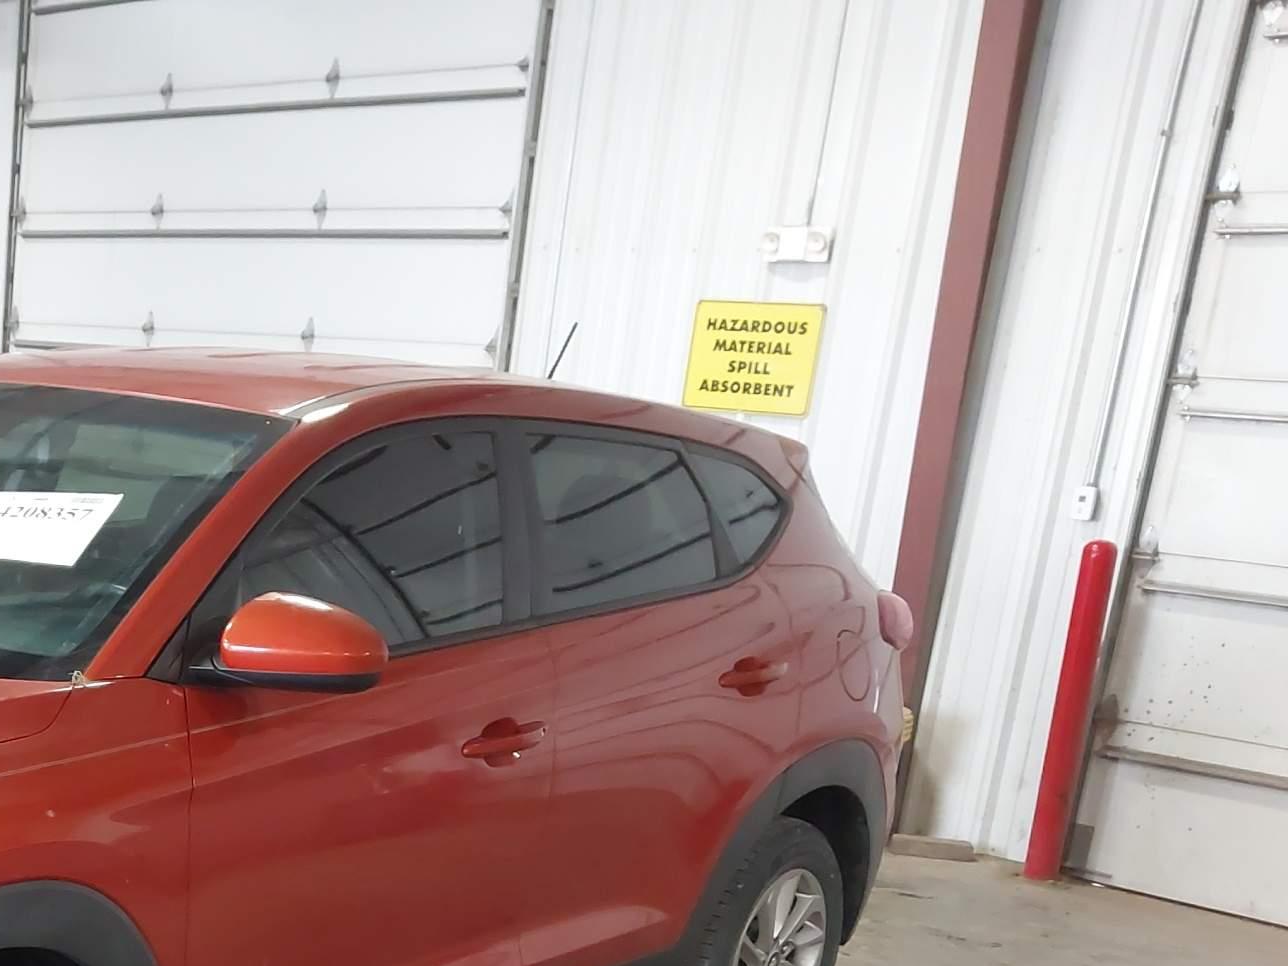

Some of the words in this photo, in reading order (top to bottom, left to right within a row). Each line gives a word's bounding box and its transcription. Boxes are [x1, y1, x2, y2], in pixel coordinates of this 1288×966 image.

[706, 318, 809, 335] HAZARDOUS
[713, 339, 792, 356] MATERIAL
[727, 360, 770, 375] SPILL
[699, 379, 795, 398] ABSORBENT
